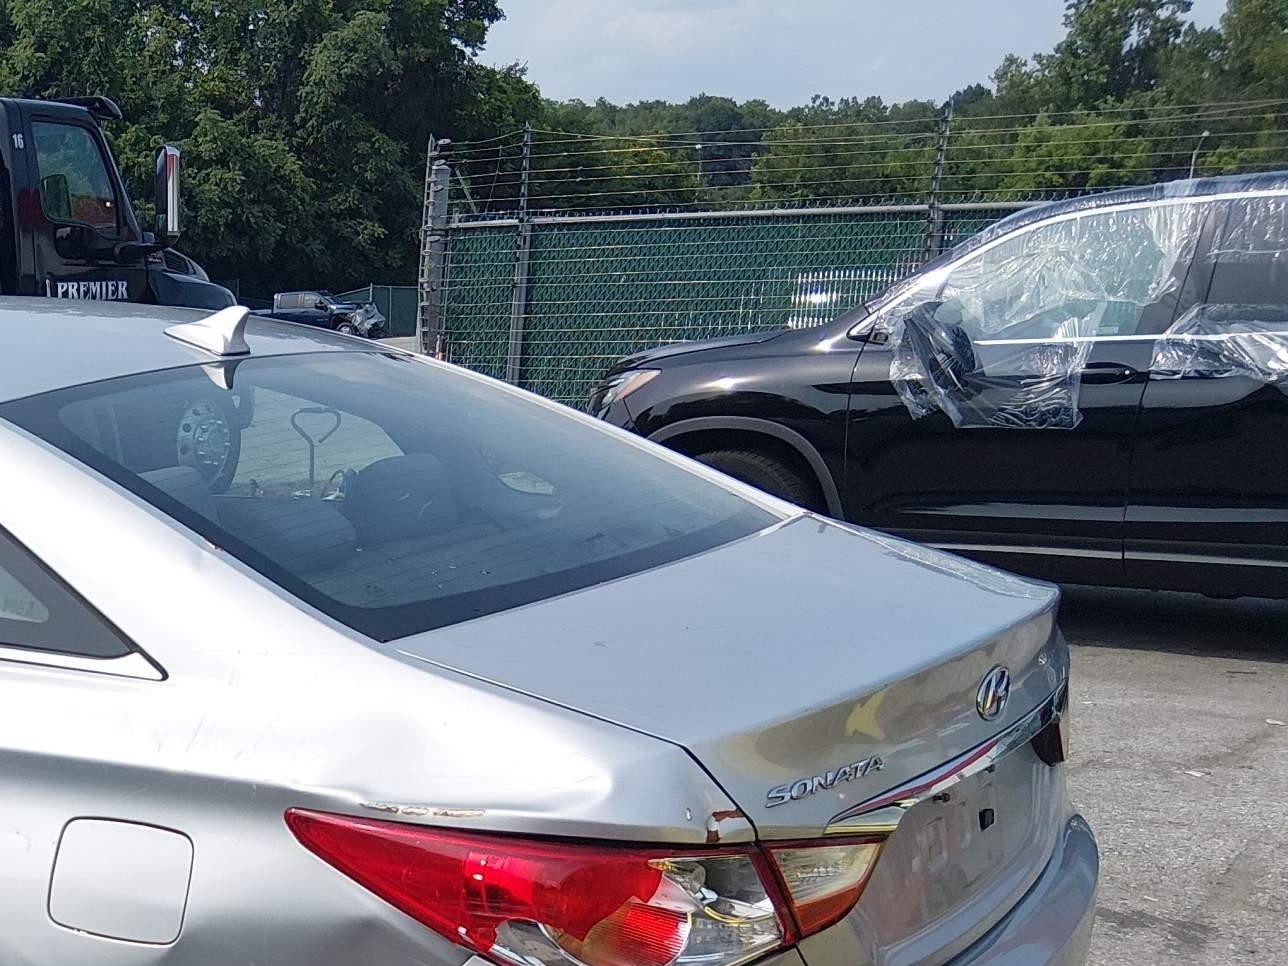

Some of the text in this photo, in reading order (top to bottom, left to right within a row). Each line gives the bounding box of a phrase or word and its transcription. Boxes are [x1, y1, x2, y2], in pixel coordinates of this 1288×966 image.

[12, 133, 24, 149] 16
[56, 280, 129, 301] PREMIER
[765, 754, 885, 809] SONATA
